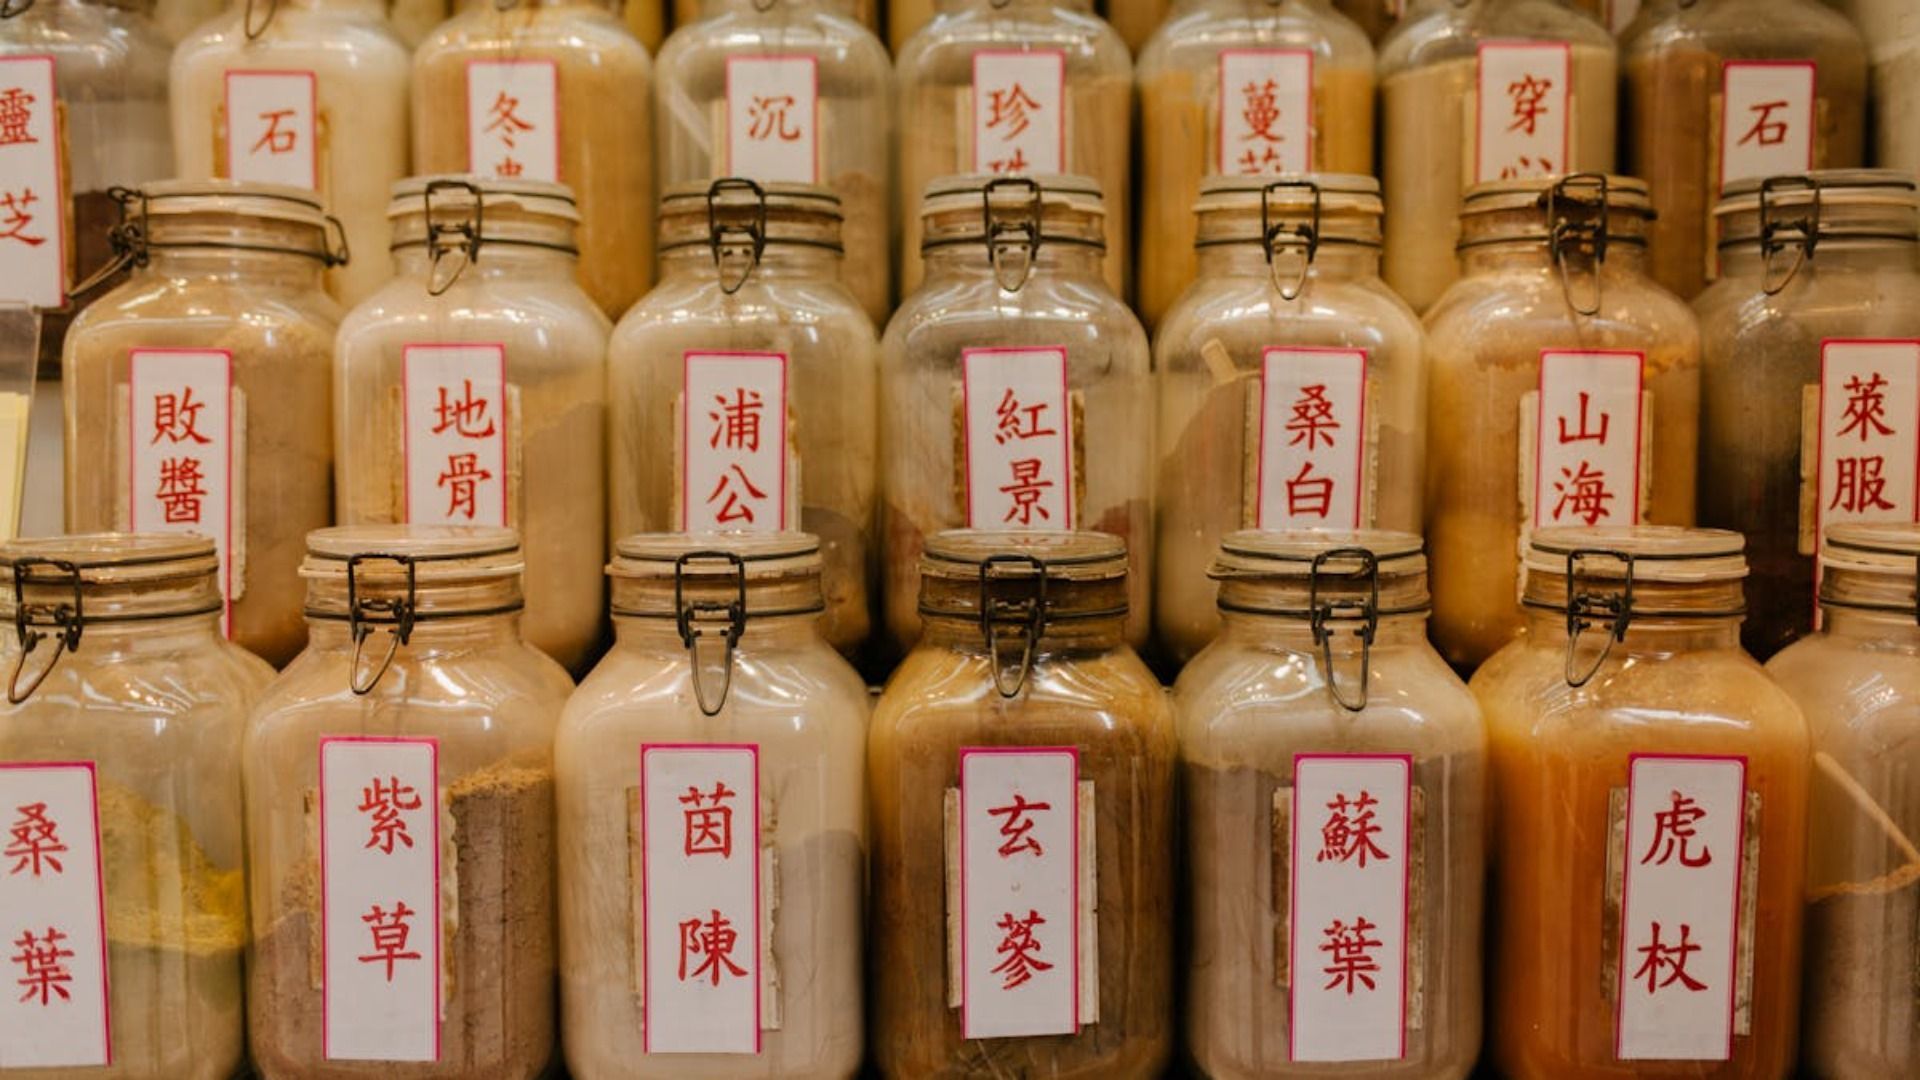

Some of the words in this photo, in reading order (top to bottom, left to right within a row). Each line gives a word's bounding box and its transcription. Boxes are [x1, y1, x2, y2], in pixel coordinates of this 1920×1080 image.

[250, 109, 297, 155] 石
[747, 95, 801, 142] 沉
[1738, 101, 1790, 147] 石
[431, 379, 496, 521] 地骨
[708, 387, 767, 525] 浦公
[996, 387, 1056, 526] 紅景
[1285, 384, 1340, 519] 桑白
[1553, 391, 1614, 526] 山海
[1829, 372, 1896, 514] 萊服
[4, 801, 74, 1006] 桑葉
[357, 776, 423, 982] 紫草
[677, 780, 749, 986] 茵陳
[987, 794, 1054, 991] 玄蔘
[1315, 790, 1390, 995] 蘇葉
[1633, 790, 1712, 995] 虎杖
